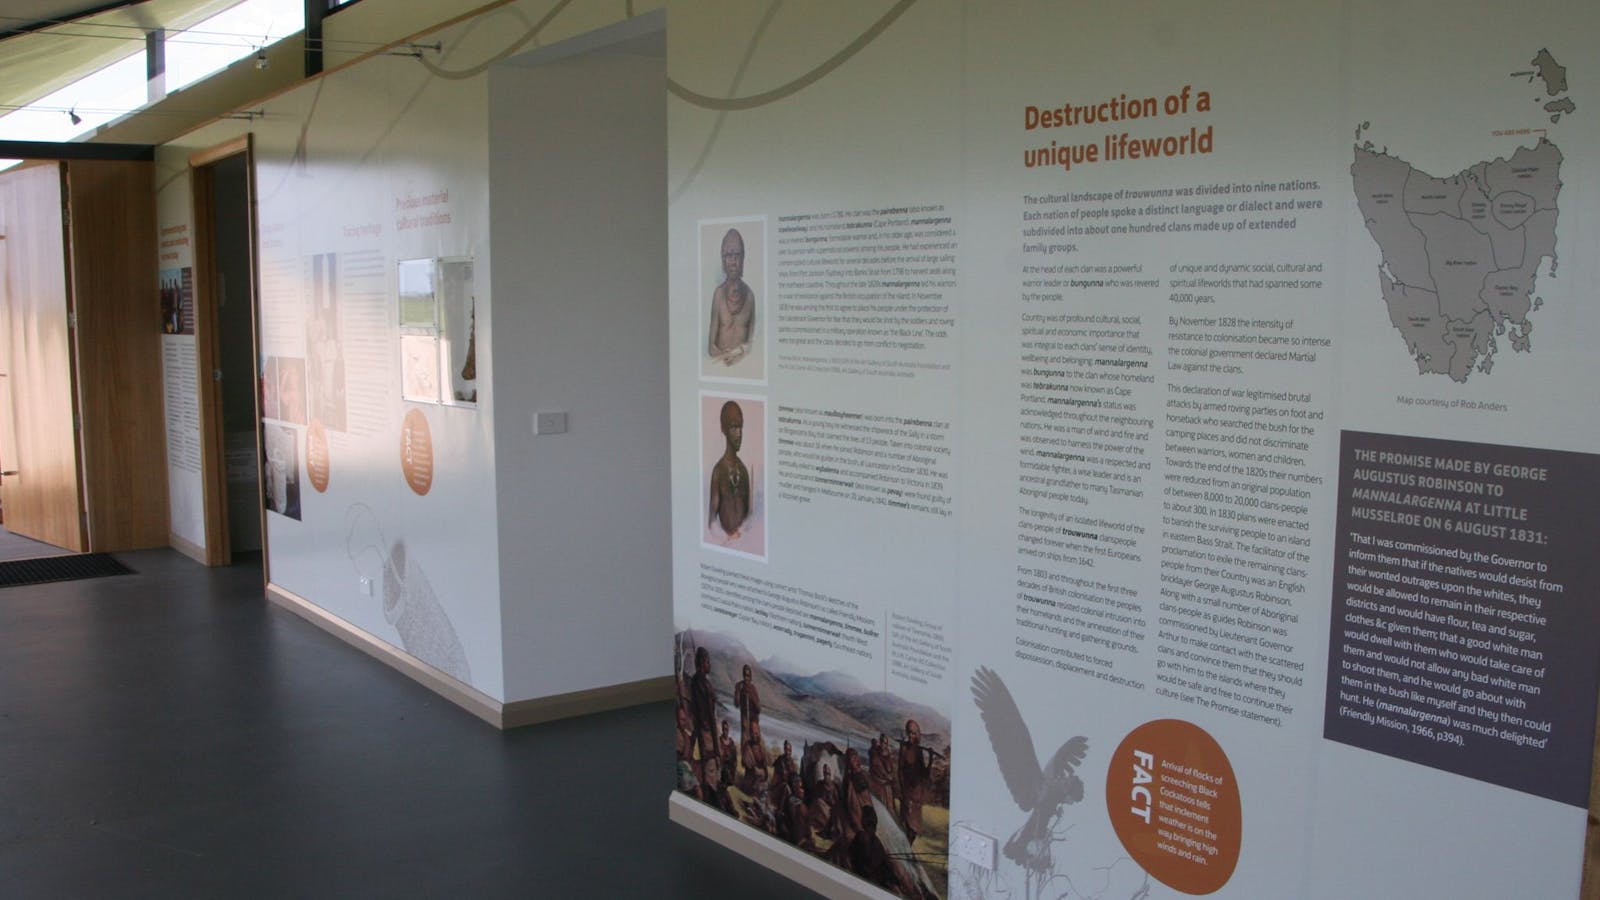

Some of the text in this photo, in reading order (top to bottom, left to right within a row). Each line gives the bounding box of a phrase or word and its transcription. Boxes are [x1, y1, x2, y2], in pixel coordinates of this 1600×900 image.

[1025, 86, 1211, 131] Destruction of a
[1024, 126, 1213, 171] unique lifeworld
[1023, 195, 1037, 205] The
[1039, 193, 1069, 204] cultural
[1070, 192, 1112, 203] landscape
[1114, 190, 1123, 200] of
[1124, 189, 1173, 200] trouwunna
[1175, 188, 1193, 197] was
[1195, 184, 1230, 196] divided
[1232, 184, 1252, 194] into
[1254, 183, 1276, 193] nine
[1023, 199, 1323, 221] Each nation of people spoke a distinct language or dialect and were
[1023, 218, 1297, 236] subdivided into about one hundred clans made up of extended
[1023, 243, 1079, 254] family groups.
[1168, 317, 1294, 330] By November 1828 the intensity of
[1168, 362, 1181, 371] Law
[1182, 363, 1207, 373] against
[1209, 363, 1221, 373] the
[1397, 396, 1508, 412] Map courtesy of Rob Anders
[1165, 443, 1195, 455] between
[1228, 451, 1256, 461] women
[1257, 452, 1272, 463] and
[1354, 449, 1548, 481] THE PROMISE MADE BY GEORGE
[1353, 469, 1503, 497] AUGUSTUS ROBINSON TO
[1352, 488, 1528, 521] MANNALARGENNA AT LITTLE
[1351, 506, 1548, 545] MUSSELROE ON 6 AUGUST 1831:
[1372, 536, 1375, 546] I
[1376, 538, 1393, 549] was
[1394, 541, 1458, 559] commissioned
[1459, 549, 1471, 563] by
[1473, 551, 1489, 564] the
[1490, 553, 1535, 571] Governor
[1536, 561, 1547, 573] to
[1348, 548, 1563, 592] inform them that if the natives would desist from
[1348, 564, 1541, 608] their wonted outrages upon the whites, they
[1156, 688, 1178, 701] culture
[1196, 696, 1209, 708] The
[1210, 700, 1238, 716] Promise
[1339, 705, 1374, 726] (Friendly
[1376, 715, 1409, 734] Mission,
[1411, 723, 1434, 740] 1966,
[1362, 695, 1374, 707] He
[1375, 697, 1450, 727] (mannalargenna)
[1452, 718, 1470, 730] was
[1472, 722, 1498, 737] much
[1162, 759, 1223, 785] Arrival of flocks of
[1131, 750, 1154, 824] FACT
[1161, 775, 1218, 798] screeching Black
[1159, 800, 1173, 812] that
[1196, 798, 1210, 810] tells
[1158, 815, 1217, 841] weather is on the
[1157, 842, 1176, 855] winds
[1178, 849, 1191, 860] and
[1158, 829, 1218, 854] way bringing high
